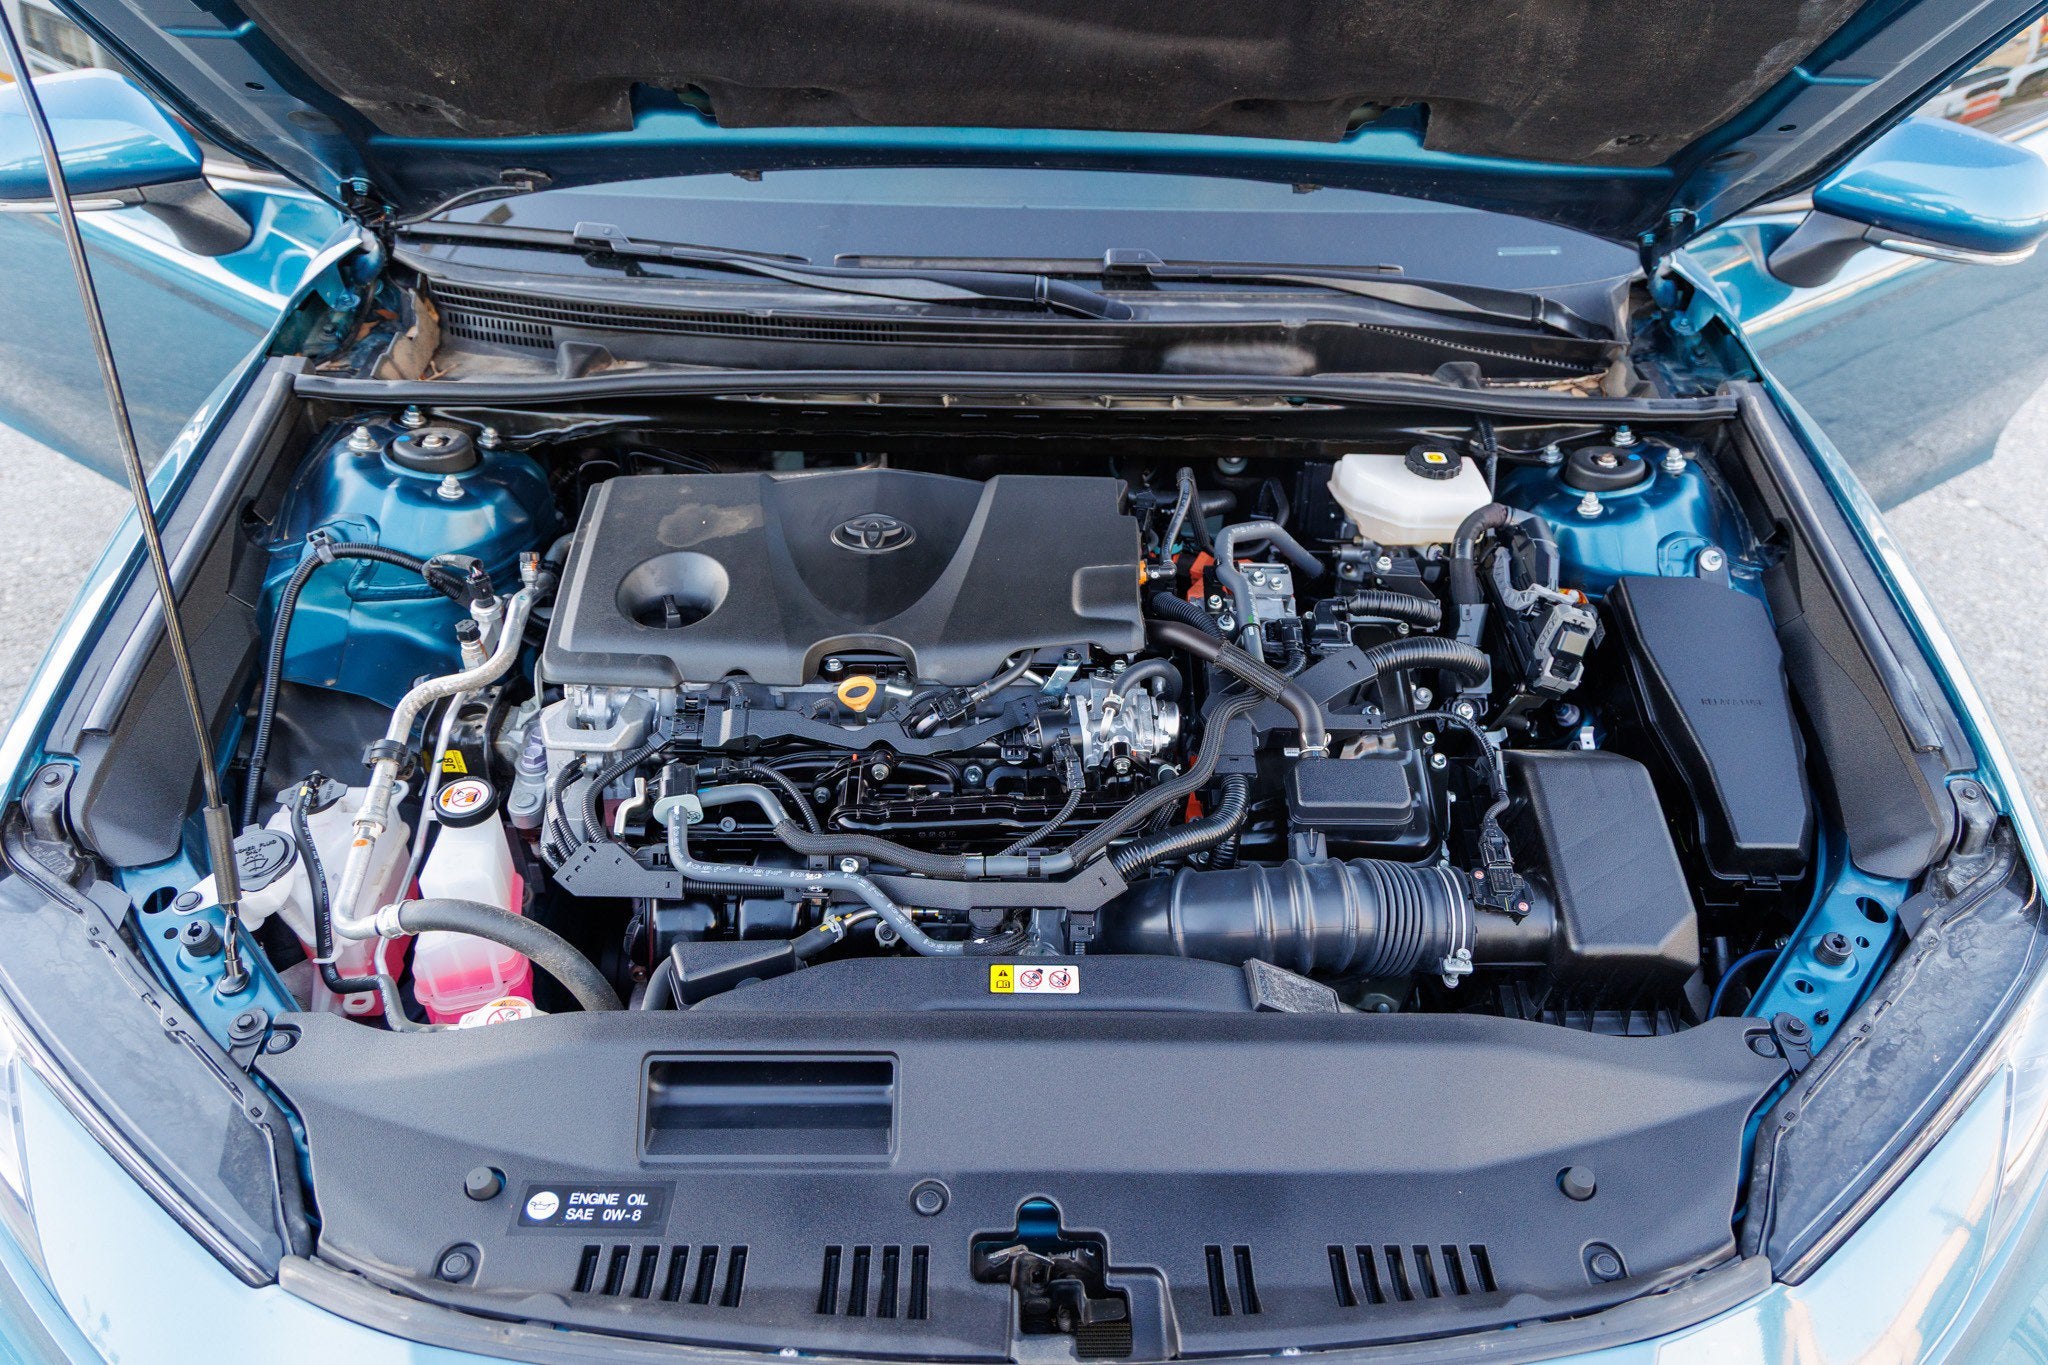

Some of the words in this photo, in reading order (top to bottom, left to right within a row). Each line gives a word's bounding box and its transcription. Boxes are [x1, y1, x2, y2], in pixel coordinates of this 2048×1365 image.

[569, 1192, 620, 1205] ENGINE
[627, 1193, 649, 1206] OIL
[565, 1208, 594, 1221] SAE
[602, 1209, 642, 1221] 0W-8
